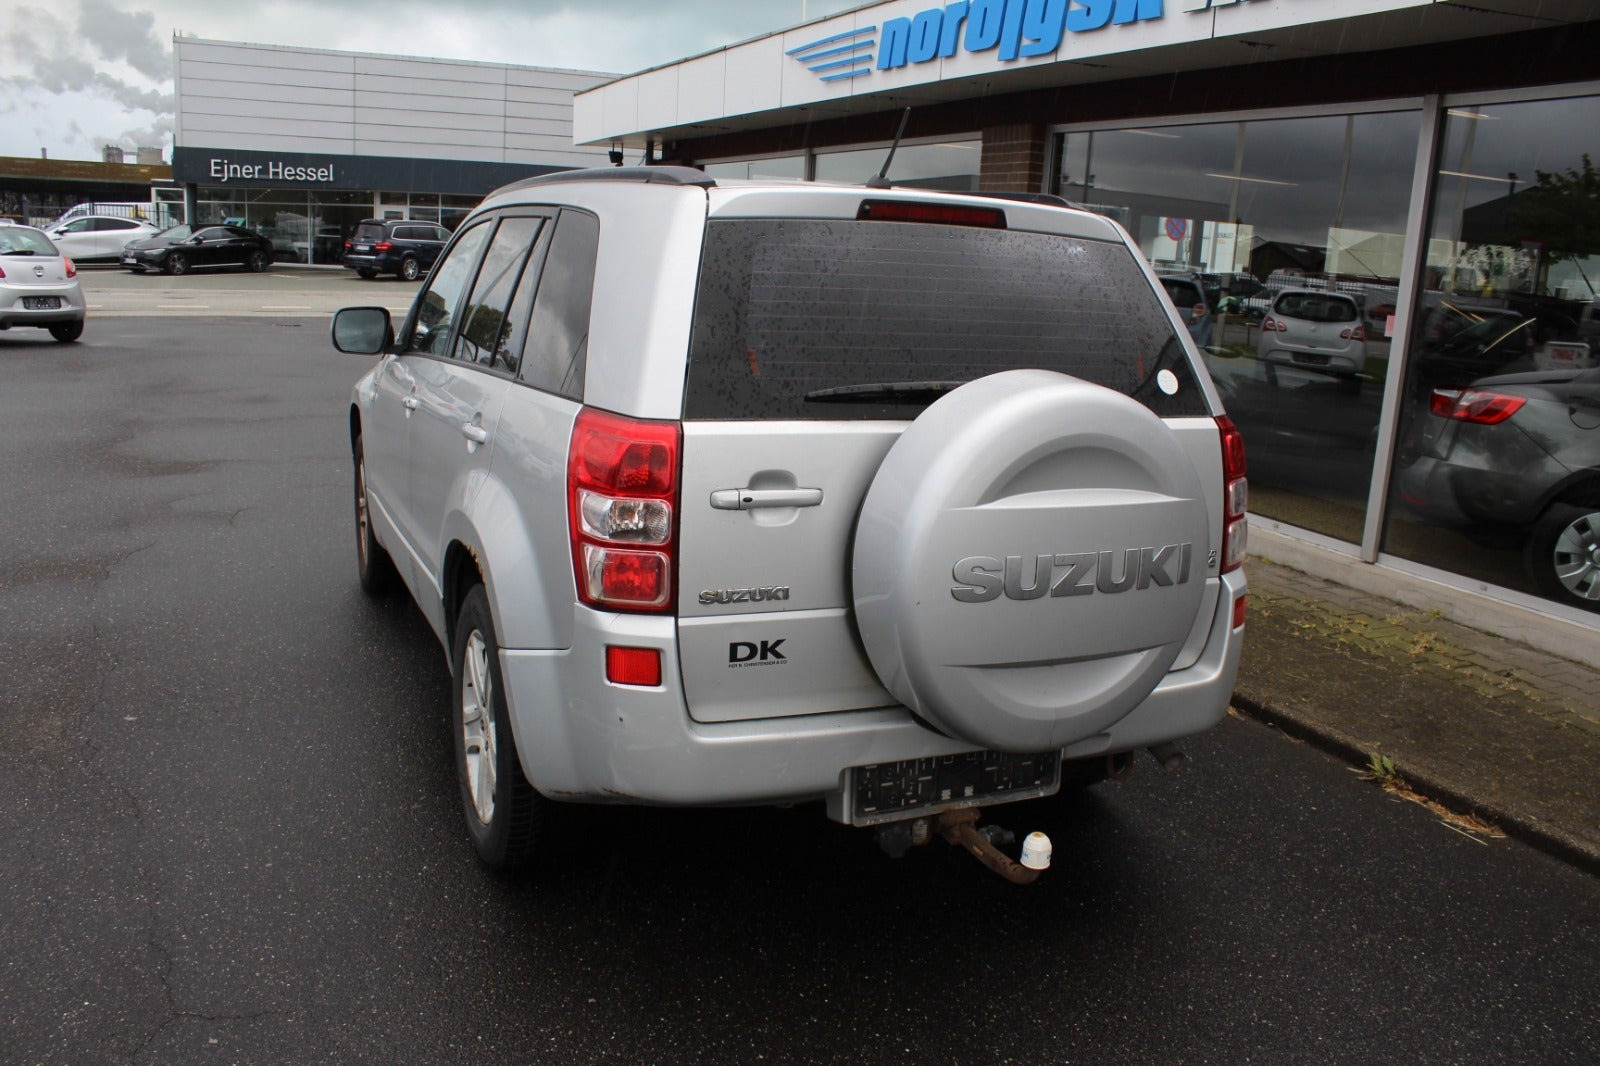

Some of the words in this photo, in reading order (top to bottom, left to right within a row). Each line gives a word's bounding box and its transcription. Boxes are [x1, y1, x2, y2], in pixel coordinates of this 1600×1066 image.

[210, 159, 262, 182] Ejner
[268, 161, 333, 181] Hessel
[951, 542, 1192, 603] SUZUKI
[698, 586, 790, 604] SUZUKI
[729, 638, 787, 663] DK
